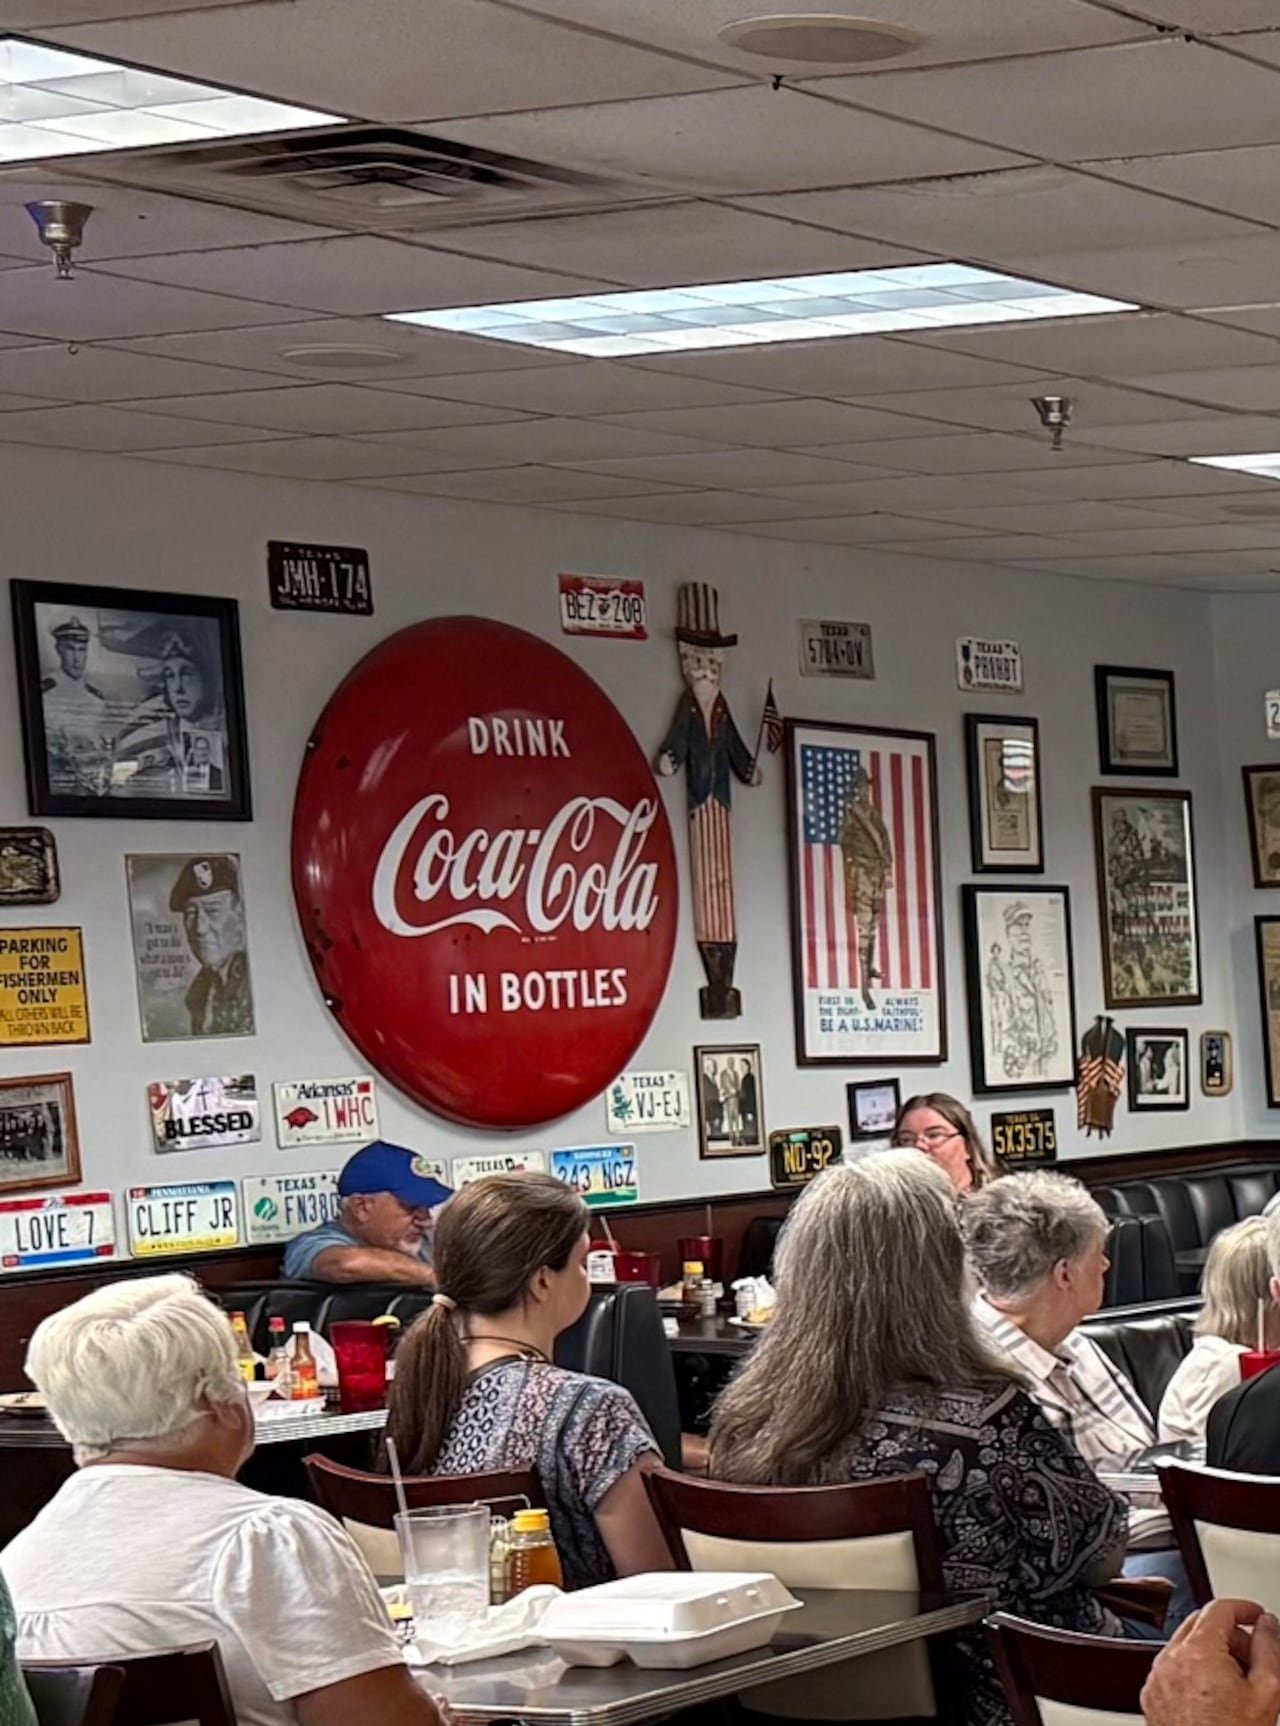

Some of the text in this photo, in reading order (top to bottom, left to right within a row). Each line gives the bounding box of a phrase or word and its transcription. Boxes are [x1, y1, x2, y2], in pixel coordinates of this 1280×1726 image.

[467, 716, 572, 758] DRINK
[372, 793, 658, 937] Coca-Cola
[0, 937, 68, 955] PARKING
[19, 954, 50, 971] FOR
[17, 988, 58, 1005] ONLY
[449, 967, 628, 1014] IN BOTTLES
[885, 996, 919, 1006] ALWAYS
[15, 1006, 50, 1021] OTHERS
[50, 1005, 71, 1019] WILL
[72, 1005, 83, 1018] BE
[51, 1020, 76, 1034] BACK
[820, 1019, 836, 1032] BE
[838, 1019, 849, 1031] A
[297, 1081, 356, 1099] Arkansas
[632, 1075, 665, 1089] TEXAS
[165, 1111, 252, 1139] BLESSED
[993, 1120, 1056, 1154] 5X3575
[474, 1158, 506, 1173] TEXAS
[602, 1160, 637, 1190] NGZ
[276, 1177, 316, 1193] TEXAS
[136, 1196, 234, 1237] CLIFF JR
[15, 1210, 95, 1252] LOVE 7
